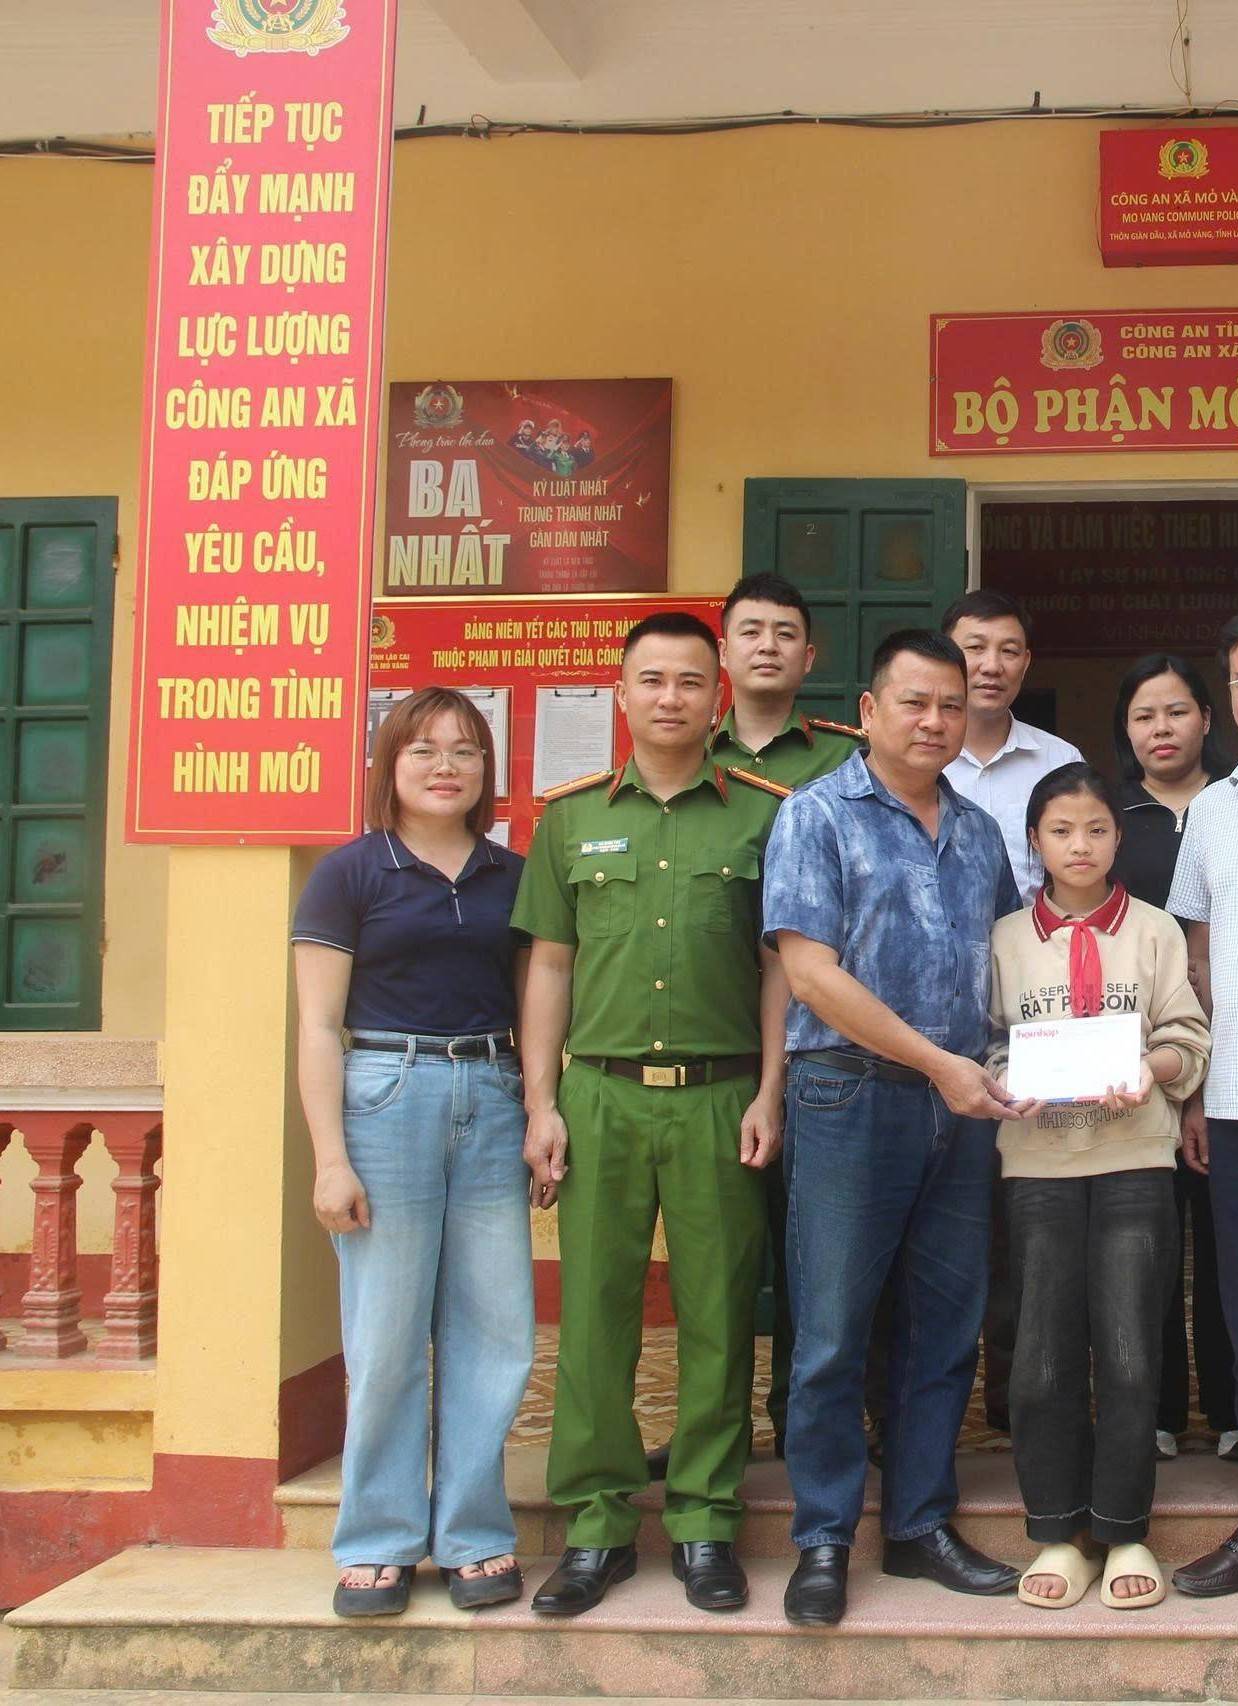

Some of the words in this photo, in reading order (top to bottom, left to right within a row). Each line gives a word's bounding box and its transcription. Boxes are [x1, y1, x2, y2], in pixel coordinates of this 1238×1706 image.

[207, 91, 274, 144] TIẾP
[285, 102, 343, 151] TỤC
[188, 158, 250, 215] ĐẨY
[259, 172, 355, 222] MẠNH
[1111, 191, 1148, 206] CÔNG
[1152, 193, 1170, 205] AN
[1174, 190, 1191, 205] XÃ
[1194, 188, 1218, 204] MỎ
[1110, 231, 1130, 240] THÔN
[1168, 230, 1177, 240] XÃ
[1122, 213, 1138, 223] MO
[1140, 212, 1164, 222] VANG
[1166, 211, 1214, 222] COMMUNE
[189, 237, 252, 286] XÂY
[260, 240, 346, 292] DỰNG
[178, 312, 237, 366] LỰC
[247, 310, 350, 364] LƯỢNG
[1120, 322, 1174, 339] CÔNG
[1181, 324, 1209, 338] AN
[1122, 344, 1176, 360] CÔNG
[1184, 345, 1211, 358] AN
[166, 379, 251, 429] CÔNG
[259, 386, 304, 427] AN
[315, 377, 357, 426] XÃ
[953, 375, 1019, 445] BỘ
[1033, 373, 1175, 442] PHẬN
[188, 450, 251, 501] ĐÁP
[262, 450, 328, 499] ỨNG
[408, 459, 481, 518] BA
[550, 478, 578, 500] LUẬT
[580, 474, 608, 496] NHẤT
[518, 505, 553, 523] TRUNG
[594, 500, 624, 522] NHẤT
[530, 526, 552, 548] GẦN
[580, 526, 610, 547] NHẤT
[185, 523, 243, 573] YÊU
[253, 517, 325, 576] CẦU,
[388, 518, 512, 586] NHẤT
[176, 596, 279, 655] NHIỆM
[289, 604, 329, 654] VỤ
[464, 615, 493, 640] BẢNG
[496, 618, 522, 640] NIÊM
[526, 615, 544, 639] YẾT
[546, 618, 568, 638] CÁC
[571, 614, 590, 638] THỦ
[593, 620, 612, 642] TỤC
[432, 646, 466, 672] THUỘC
[468, 650, 498, 672] PHẠM
[502, 650, 512, 666] VI
[514, 642, 535, 666] GIẢI
[538, 642, 570, 668] QUYẾT
[573, 641, 594, 666] CỦA
[157, 677, 261, 720] TRONG
[271, 668, 343, 719] TÌNH
[173, 742, 249, 793] HÌNH
[259, 742, 320, 793] MỚI
[1020, 998, 1056, 1020] RAT
[1062, 995, 1137, 1012] PSON
